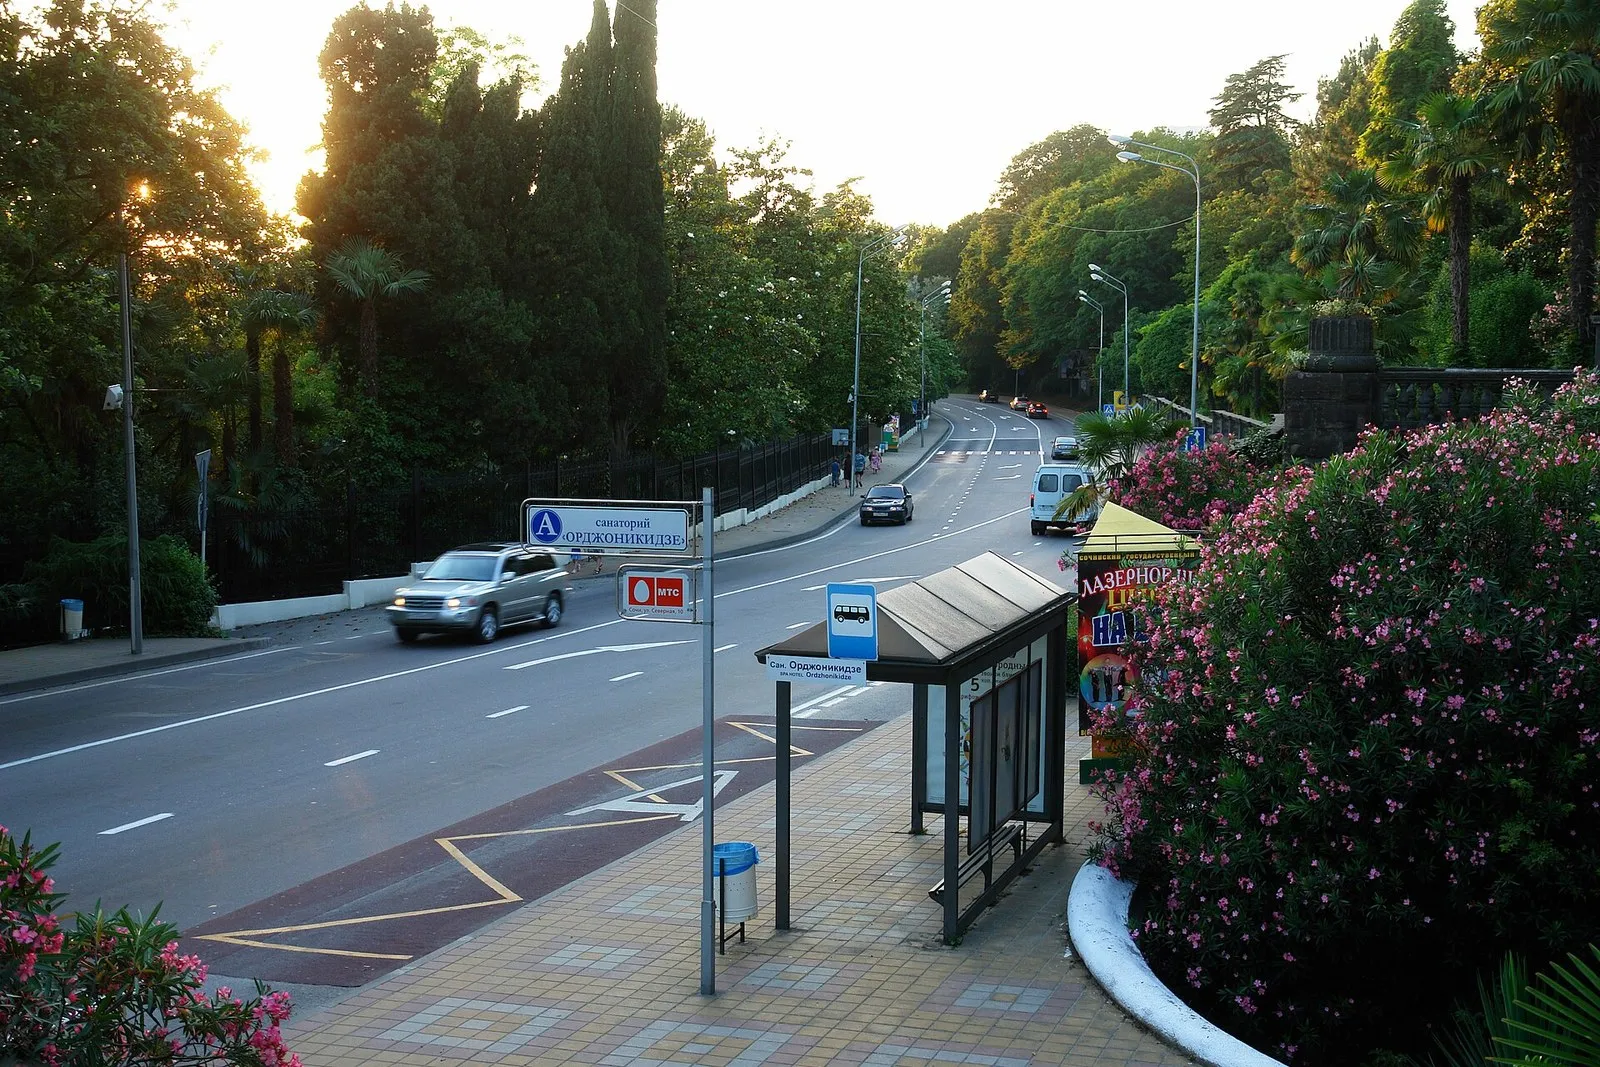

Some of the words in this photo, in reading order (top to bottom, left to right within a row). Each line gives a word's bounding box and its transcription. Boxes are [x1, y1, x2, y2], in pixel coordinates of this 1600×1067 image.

[595, 518, 650, 531] санаторий
[657, 588, 680, 597] МТС
[1092, 611, 1127, 647] НА
[769, 661, 787, 669] Сан.
[789, 660, 862, 674] Орджоникидзе
[805, 671, 852, 681] Ordzhonikidze
[970, 677, 980, 692] 5
